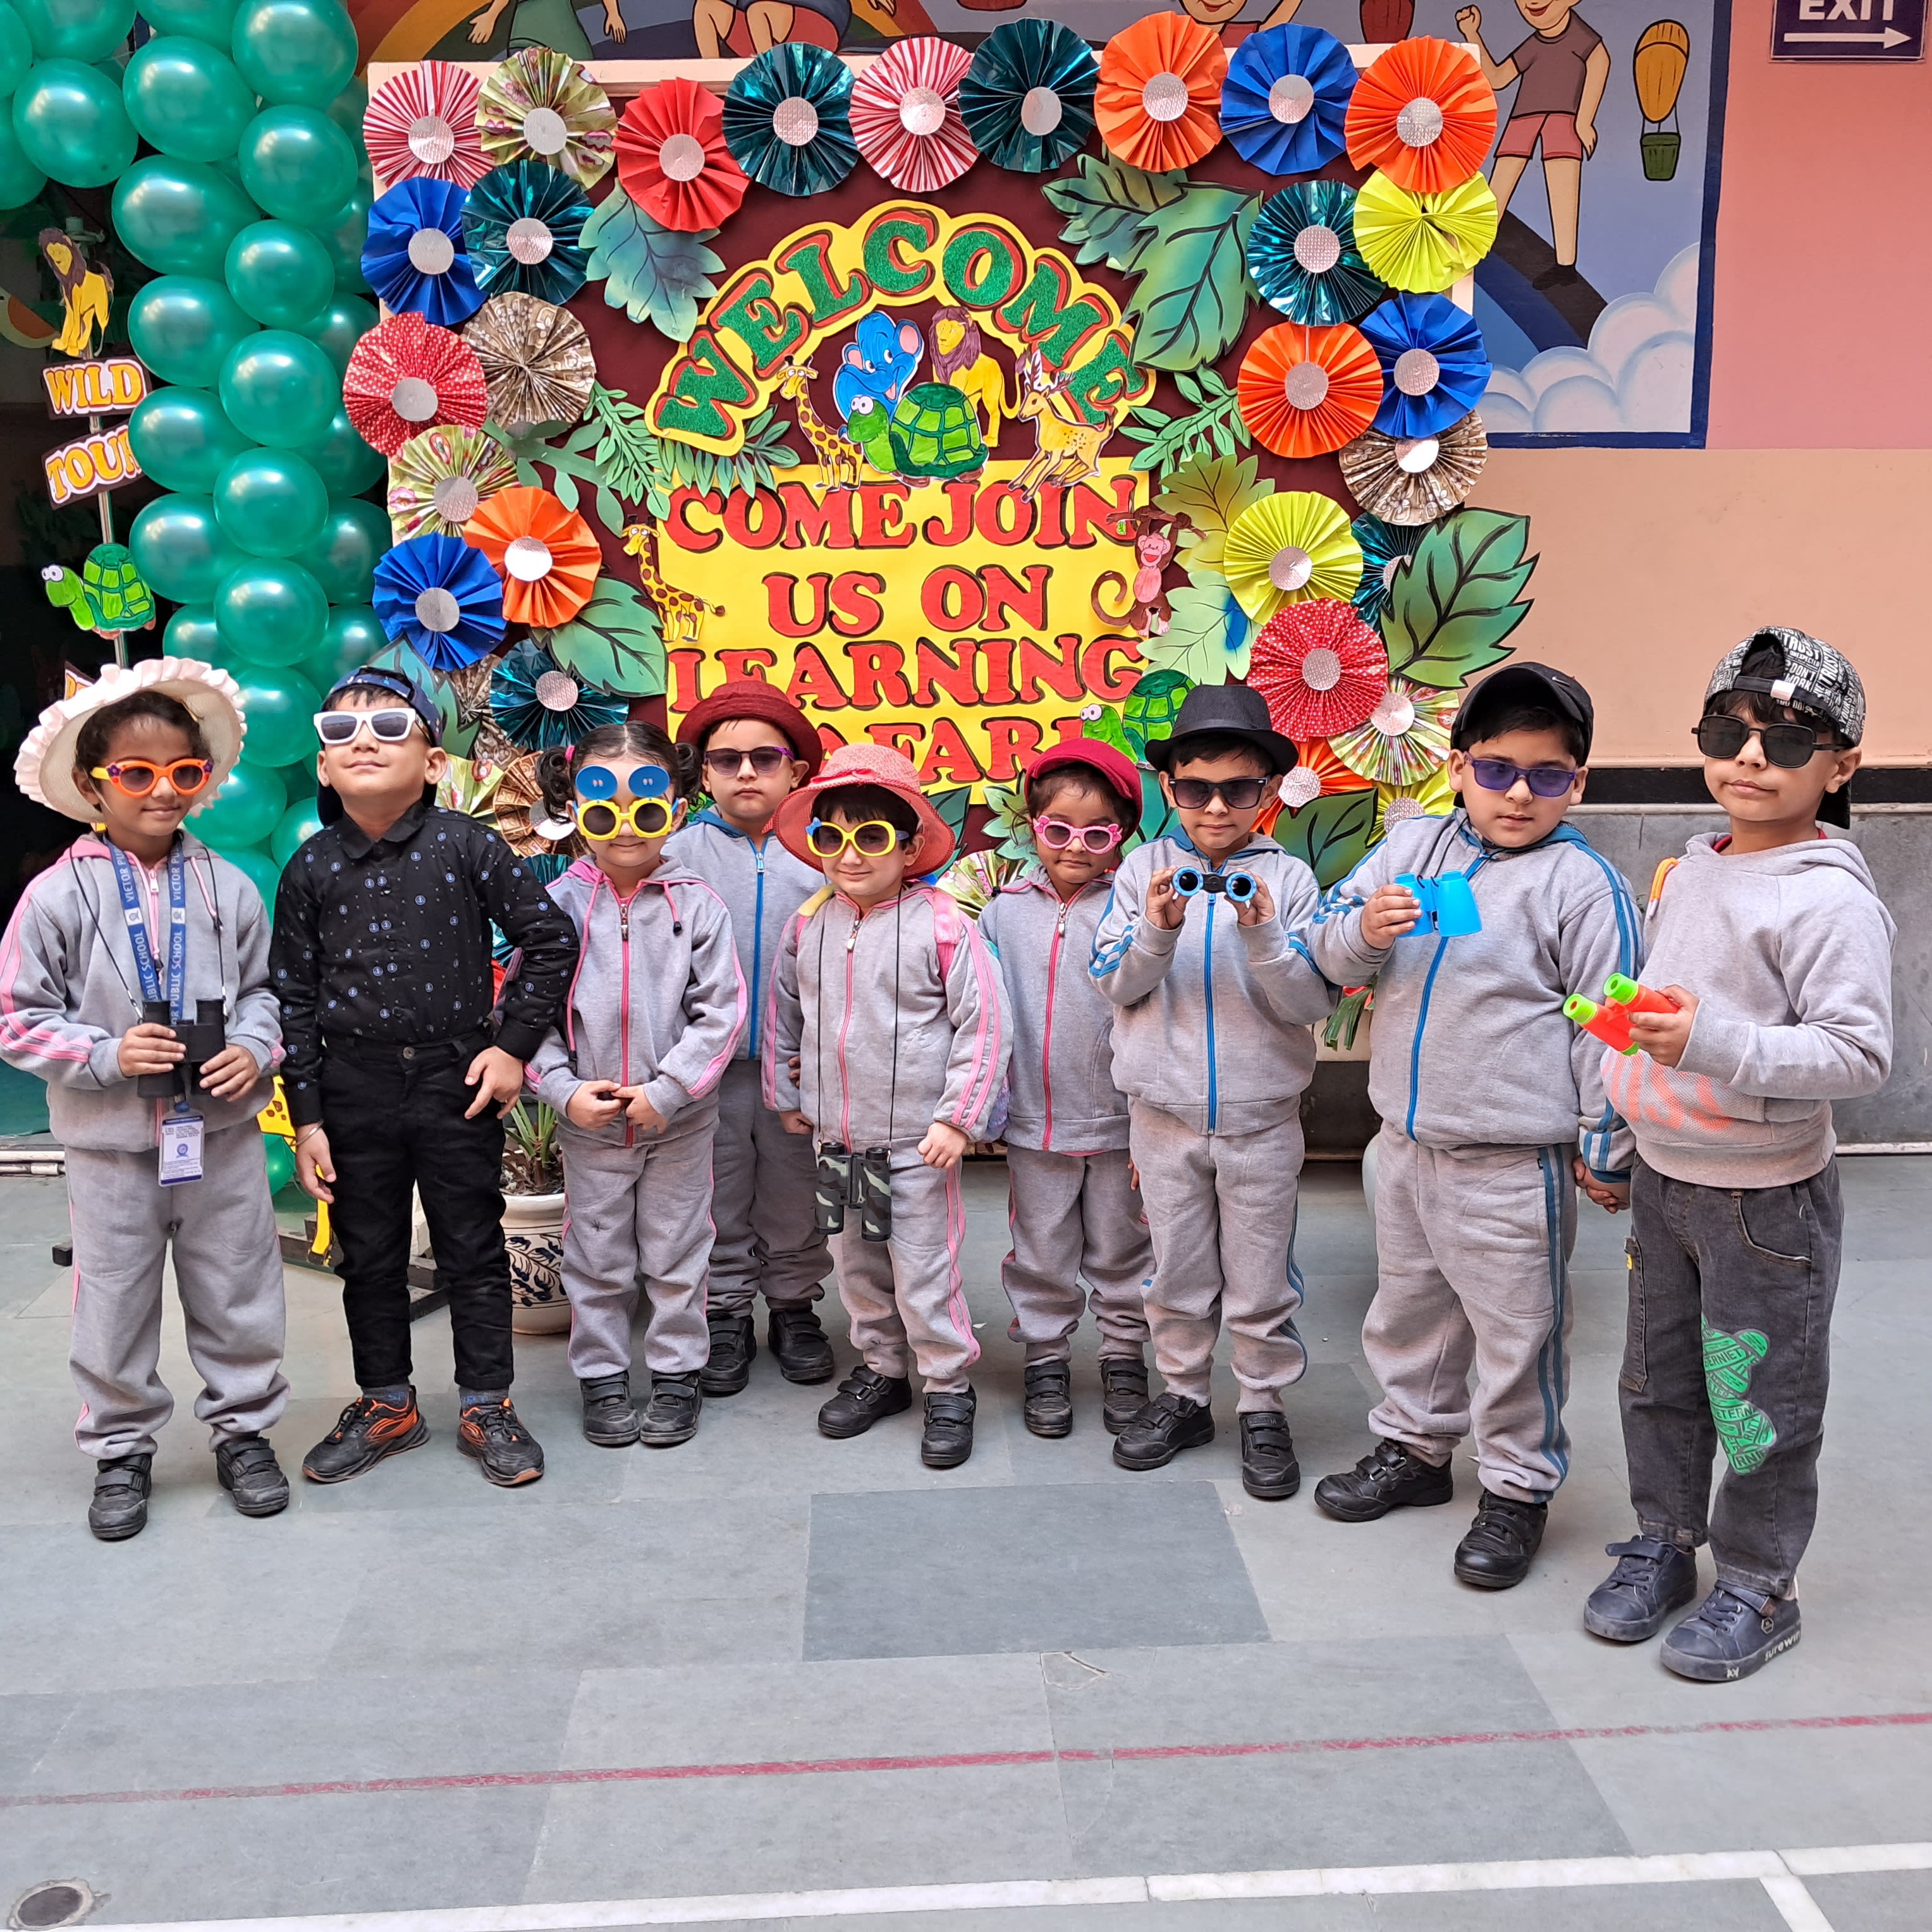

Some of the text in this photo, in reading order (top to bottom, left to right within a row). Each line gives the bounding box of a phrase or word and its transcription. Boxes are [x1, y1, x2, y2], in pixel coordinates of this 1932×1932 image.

[653, 209, 1149, 437] WELCOME
[46, 363, 144, 412] WILD
[664, 475, 1139, 552] COME JOIN
[762, 564, 1053, 639] US ON
[171, 867, 181, 901] VICTOR
[133, 930, 152, 972] SCHOOL
[171, 930, 183, 969] SCHOOL
[169, 972, 181, 1007] PUBLIC
